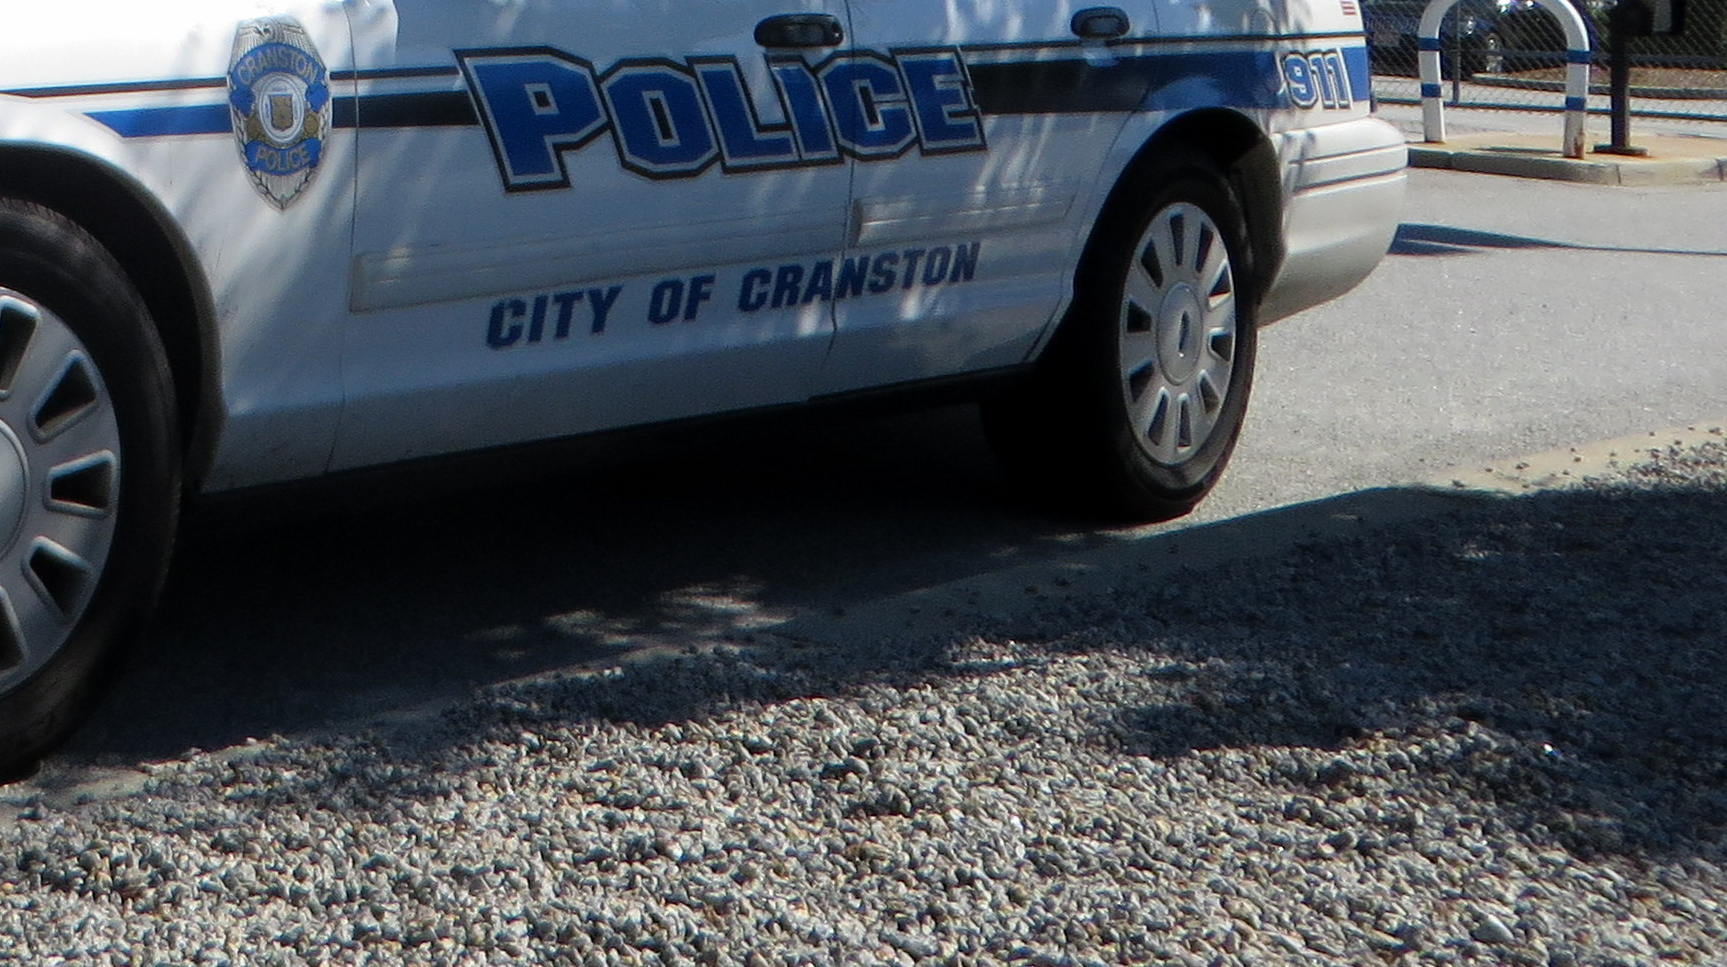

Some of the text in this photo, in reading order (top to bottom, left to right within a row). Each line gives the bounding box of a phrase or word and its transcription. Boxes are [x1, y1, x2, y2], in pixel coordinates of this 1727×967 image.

[238, 48, 318, 85] CRANSTON
[1283, 48, 1352, 109] 911
[453, 45, 987, 193] POLICE
[255, 146, 310, 171] POLICE
[486, 241, 981, 350] CITY OF CRANSTON
